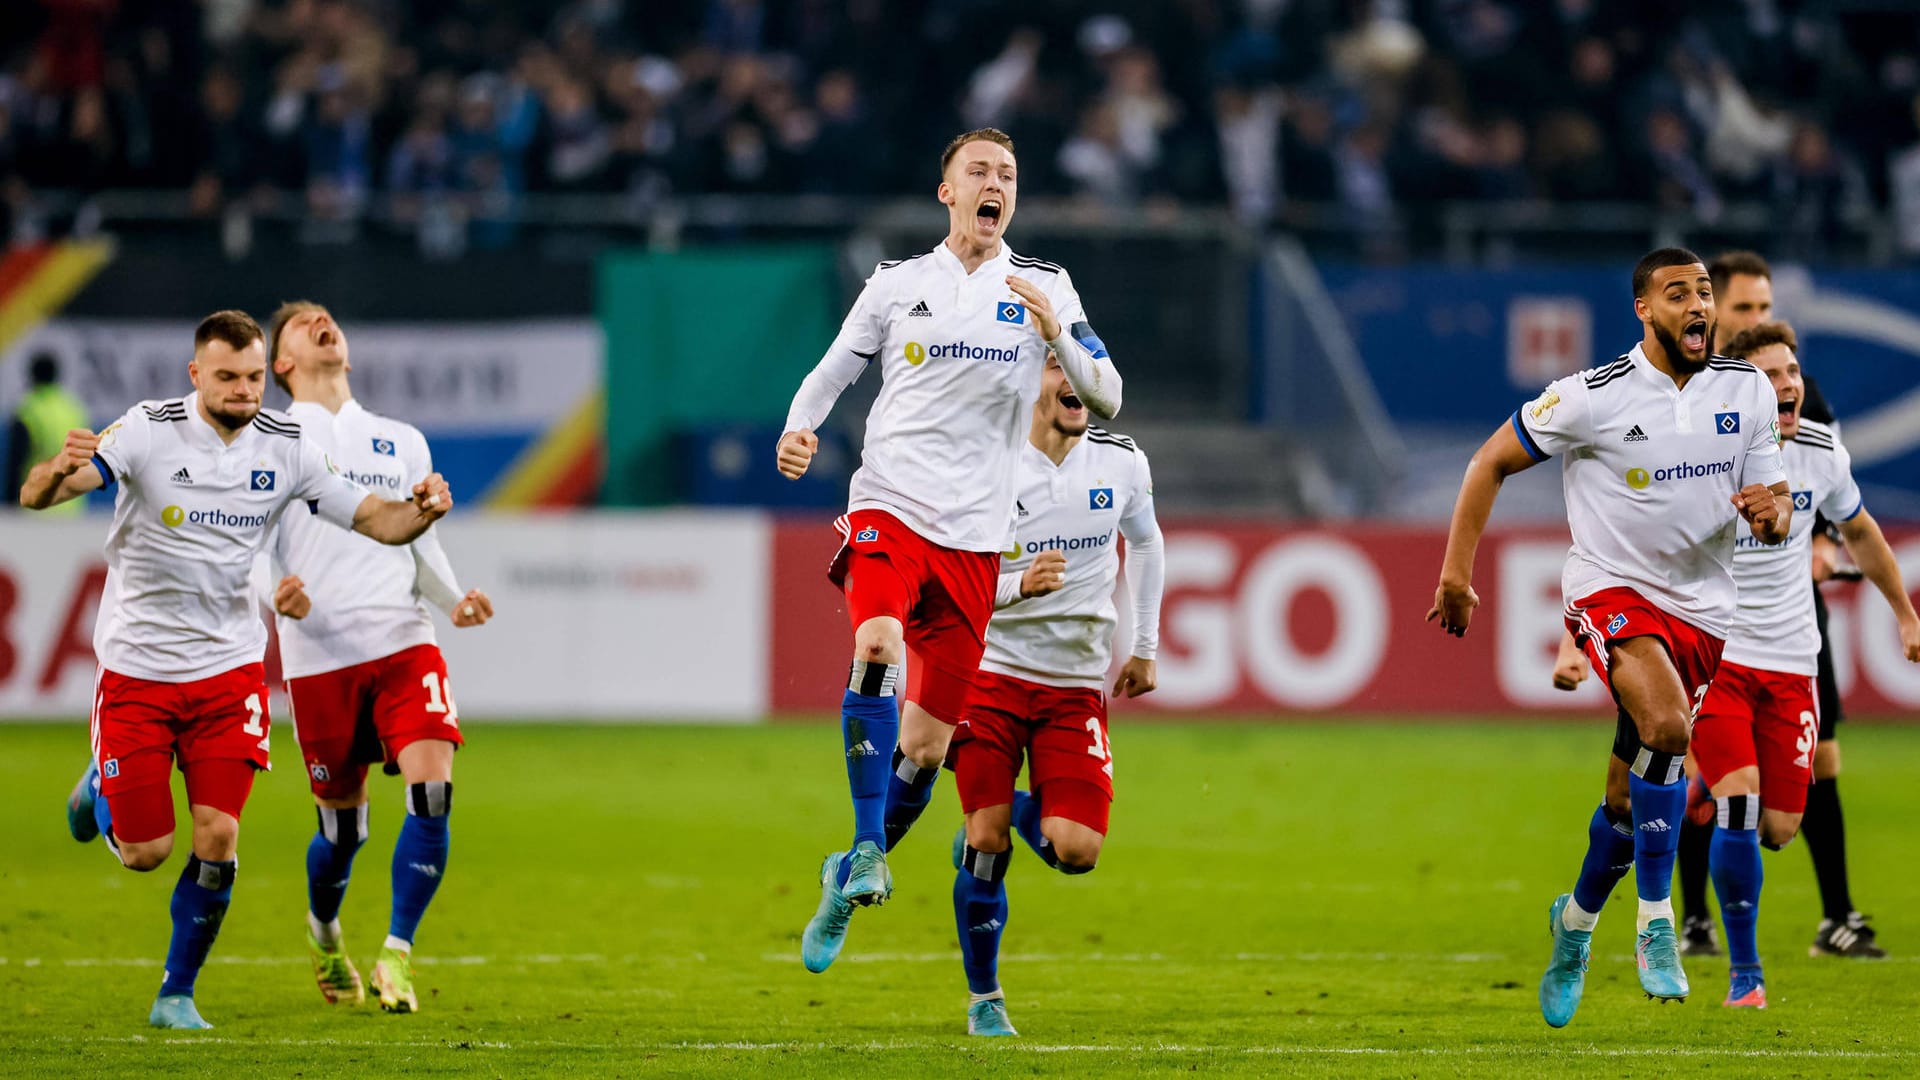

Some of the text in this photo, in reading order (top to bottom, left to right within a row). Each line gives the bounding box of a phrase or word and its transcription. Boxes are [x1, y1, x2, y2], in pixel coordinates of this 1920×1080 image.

[929, 341, 1019, 362] orthomol
[1654, 456, 1735, 481] orthomol
[189, 509, 270, 527] orthomol
[1026, 528, 1113, 553] orthomol
[1112, 533, 1391, 709] GO
[243, 693, 271, 737] 1
[1085, 716, 1112, 761] 1
